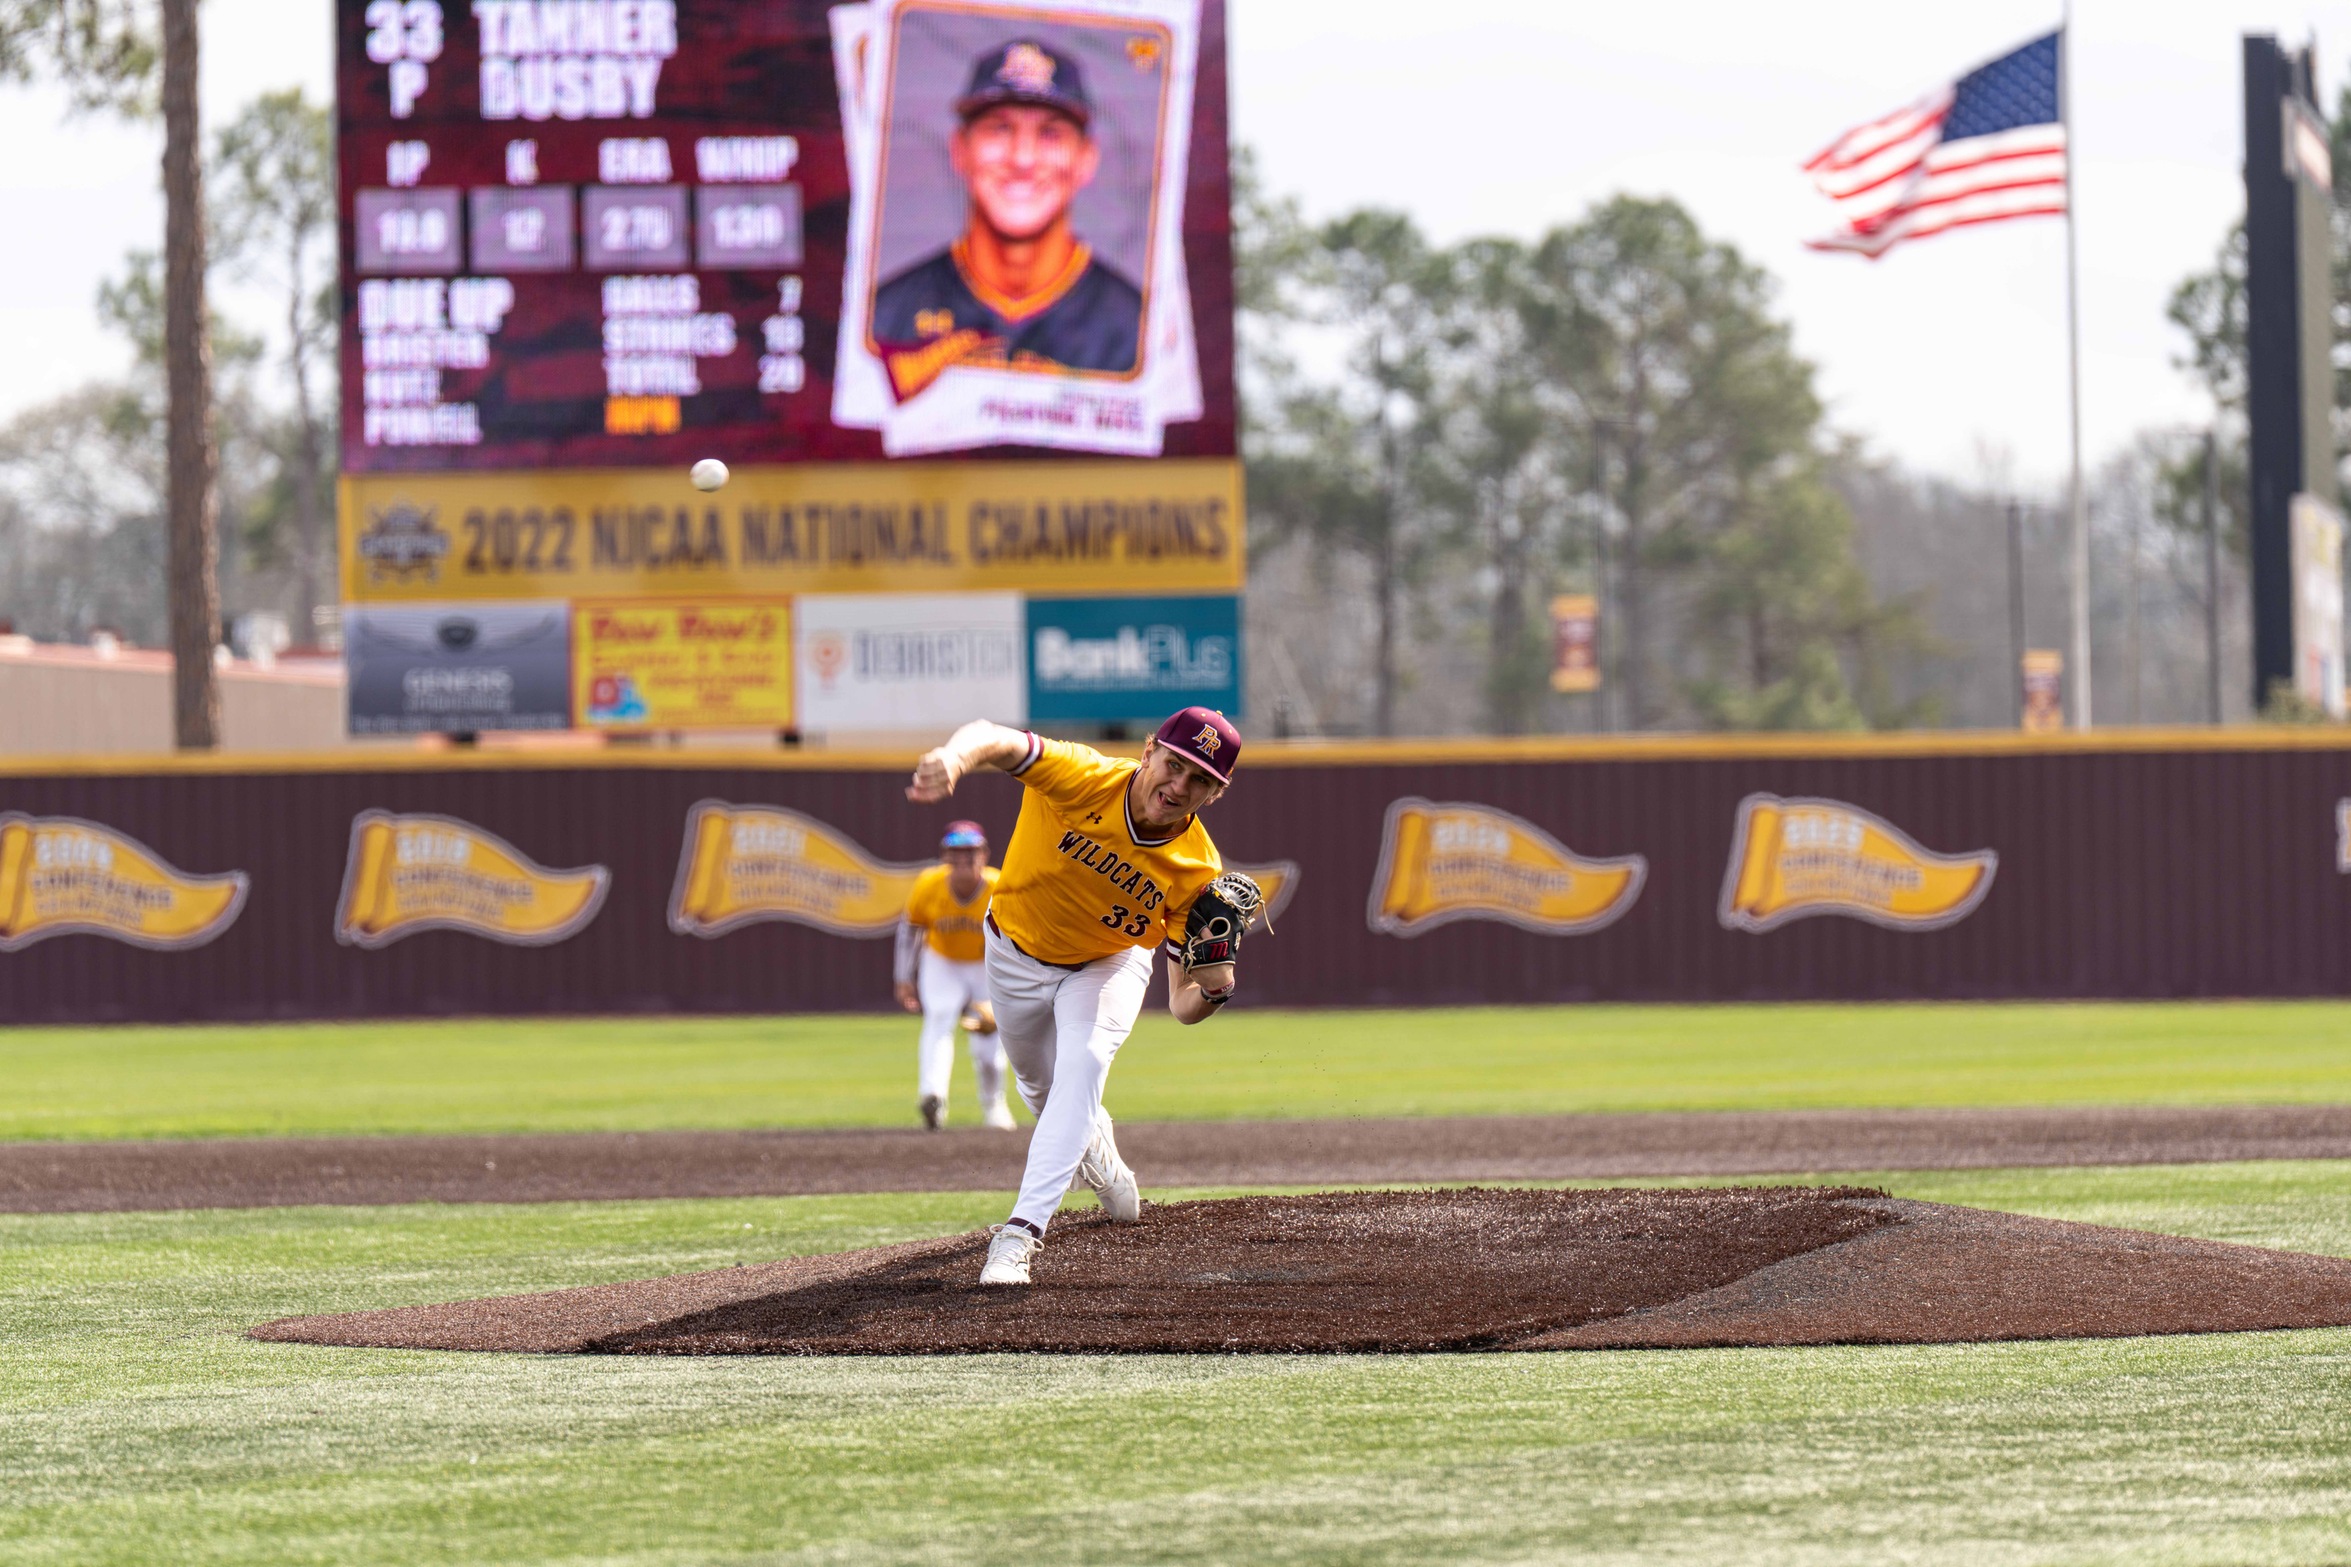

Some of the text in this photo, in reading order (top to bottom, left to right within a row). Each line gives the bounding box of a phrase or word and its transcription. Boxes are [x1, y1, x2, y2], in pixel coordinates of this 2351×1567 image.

[366, 0, 443, 62] 33
[473, 0, 677, 56] TANNER
[390, 60, 428, 117] P
[480, 58, 662, 119] BUSBY
[599, 137, 673, 183] ERA
[449, 276, 514, 333] UP
[462, 496, 1228, 576] 2022 NJCAA NATIONAL CHAMPIONS
[1034, 624, 1232, 682] BankPlus
[1192, 723, 1221, 760] PR
[1057, 829, 1165, 912] WILDCATS
[1101, 904, 1152, 938] 33
